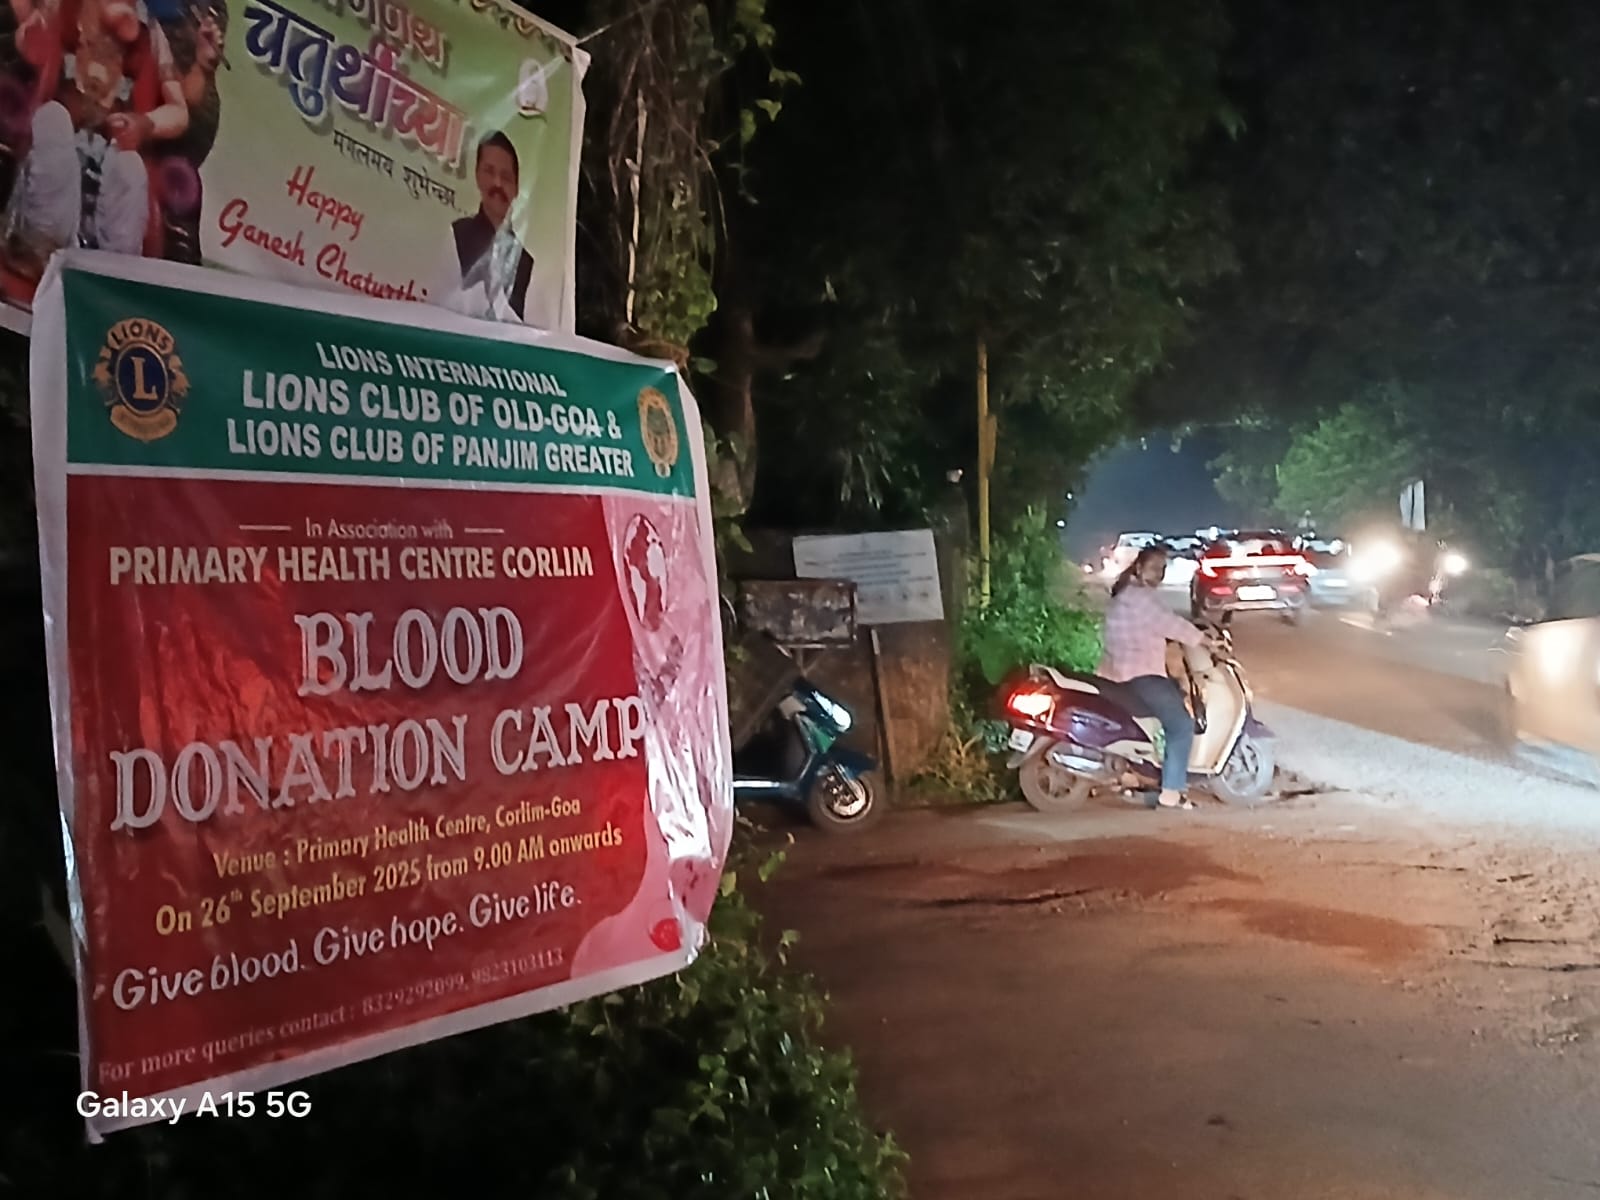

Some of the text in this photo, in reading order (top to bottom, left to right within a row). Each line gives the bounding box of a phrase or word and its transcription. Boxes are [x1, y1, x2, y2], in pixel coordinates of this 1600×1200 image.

[243, 0, 467, 168] चतुर्थीच्या
[333, 130, 393, 178] मंगलमय
[218, 198, 305, 266] Ganesh
[286, 166, 365, 241] Happy
[109, 320, 171, 352] LIONS
[316, 341, 567, 397] LIONS INTERNATIONAL
[131, 356, 158, 400] L
[243, 369, 622, 439] LIONS CLUB OF OLD-GOA &
[227, 418, 635, 477] LIONS CLUB OF PANJIM GREATER
[306, 517, 453, 539] In Association with
[110, 546, 594, 585] PRIMARY HEALTH CENTRE CORLIM
[294, 606, 524, 698] BLOOD
[110, 696, 646, 831] DONATION CAMP
[213, 851, 276, 879] Venue
[297, 834, 369, 863] Primary
[374, 816, 430, 851] Health
[435, 813, 491, 839] Centre,
[496, 795, 581, 828] Corlim-Goa
[156, 905, 192, 935] On
[251, 872, 367, 920] September
[373, 858, 421, 893] 2025
[426, 853, 468, 881] from
[474, 840, 513, 871] 9.00
[517, 834, 545, 864] AM
[549, 820, 623, 856] onwards
[112, 880, 583, 1010] Give blood. Give hope. Give life.
[98, 1060, 134, 1084] For
[141, 1046, 196, 1075] more
[202, 1026, 275, 1063] queries
[279, 1005, 346, 1038] contact
